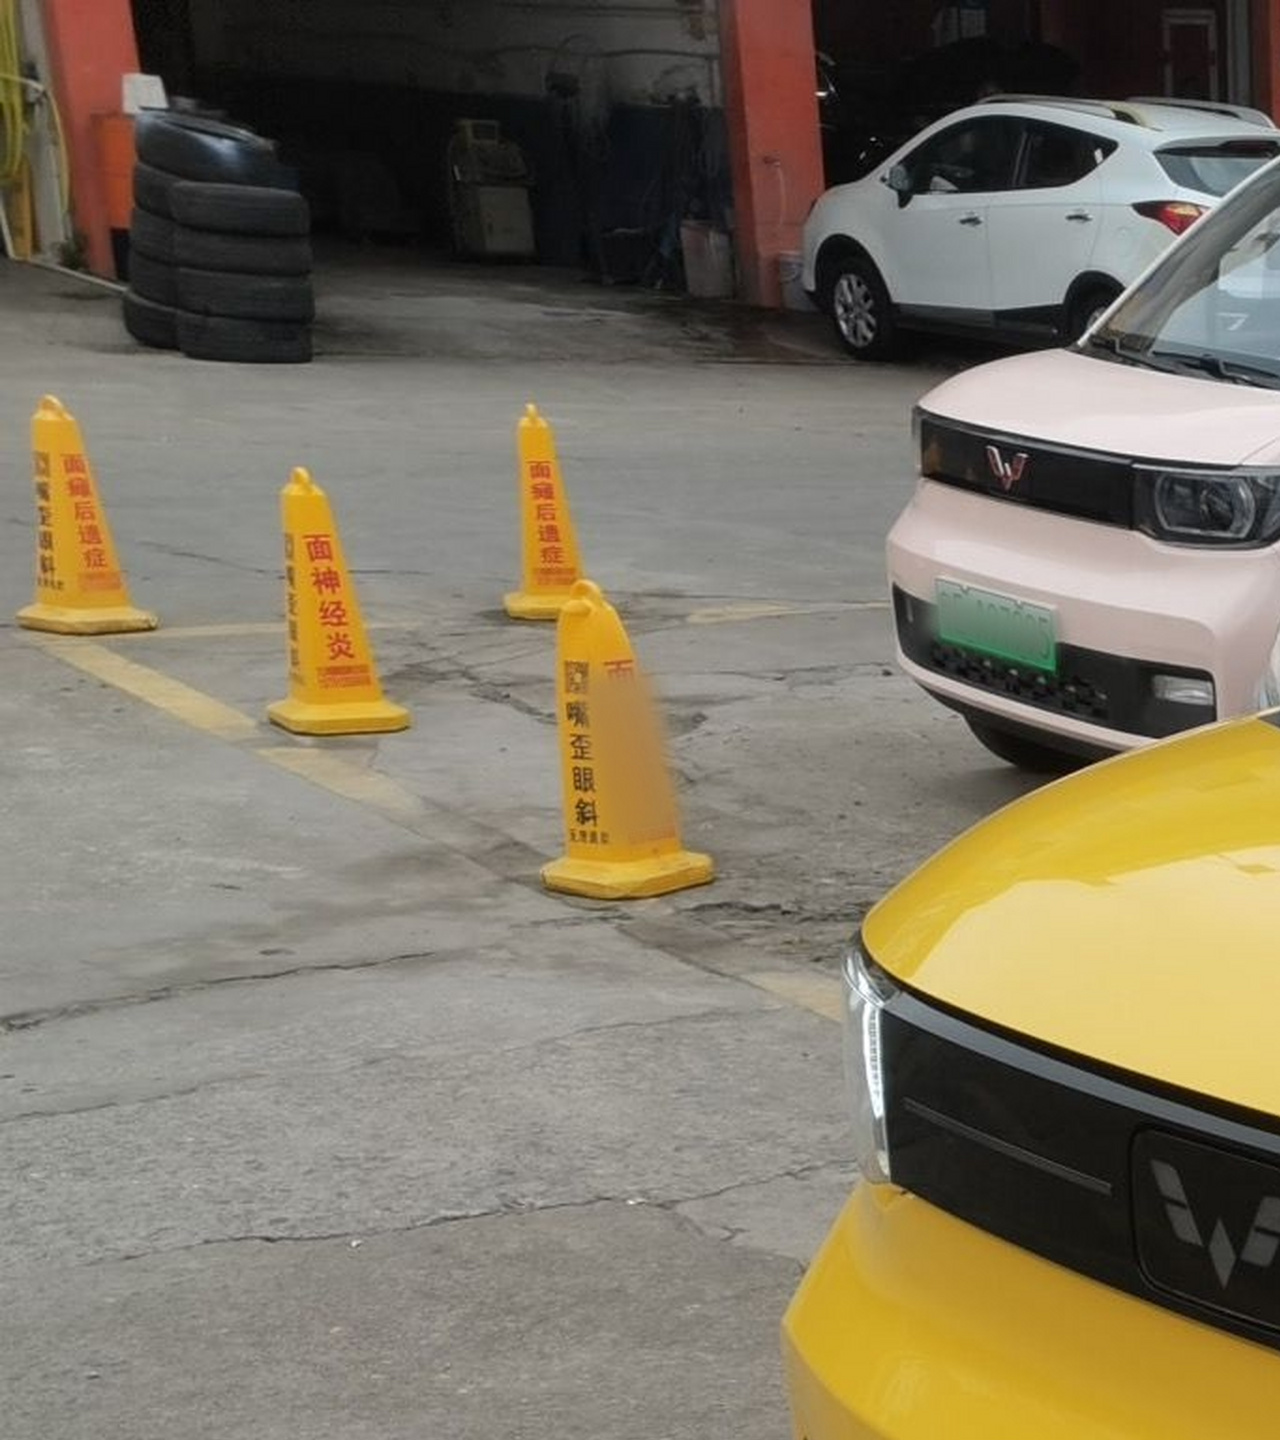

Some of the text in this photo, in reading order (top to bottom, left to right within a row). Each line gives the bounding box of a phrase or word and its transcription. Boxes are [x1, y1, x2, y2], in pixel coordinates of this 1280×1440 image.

[302, 532, 356, 662] 面神经炎
[565, 700, 599, 828] 嘴歪眼斜
